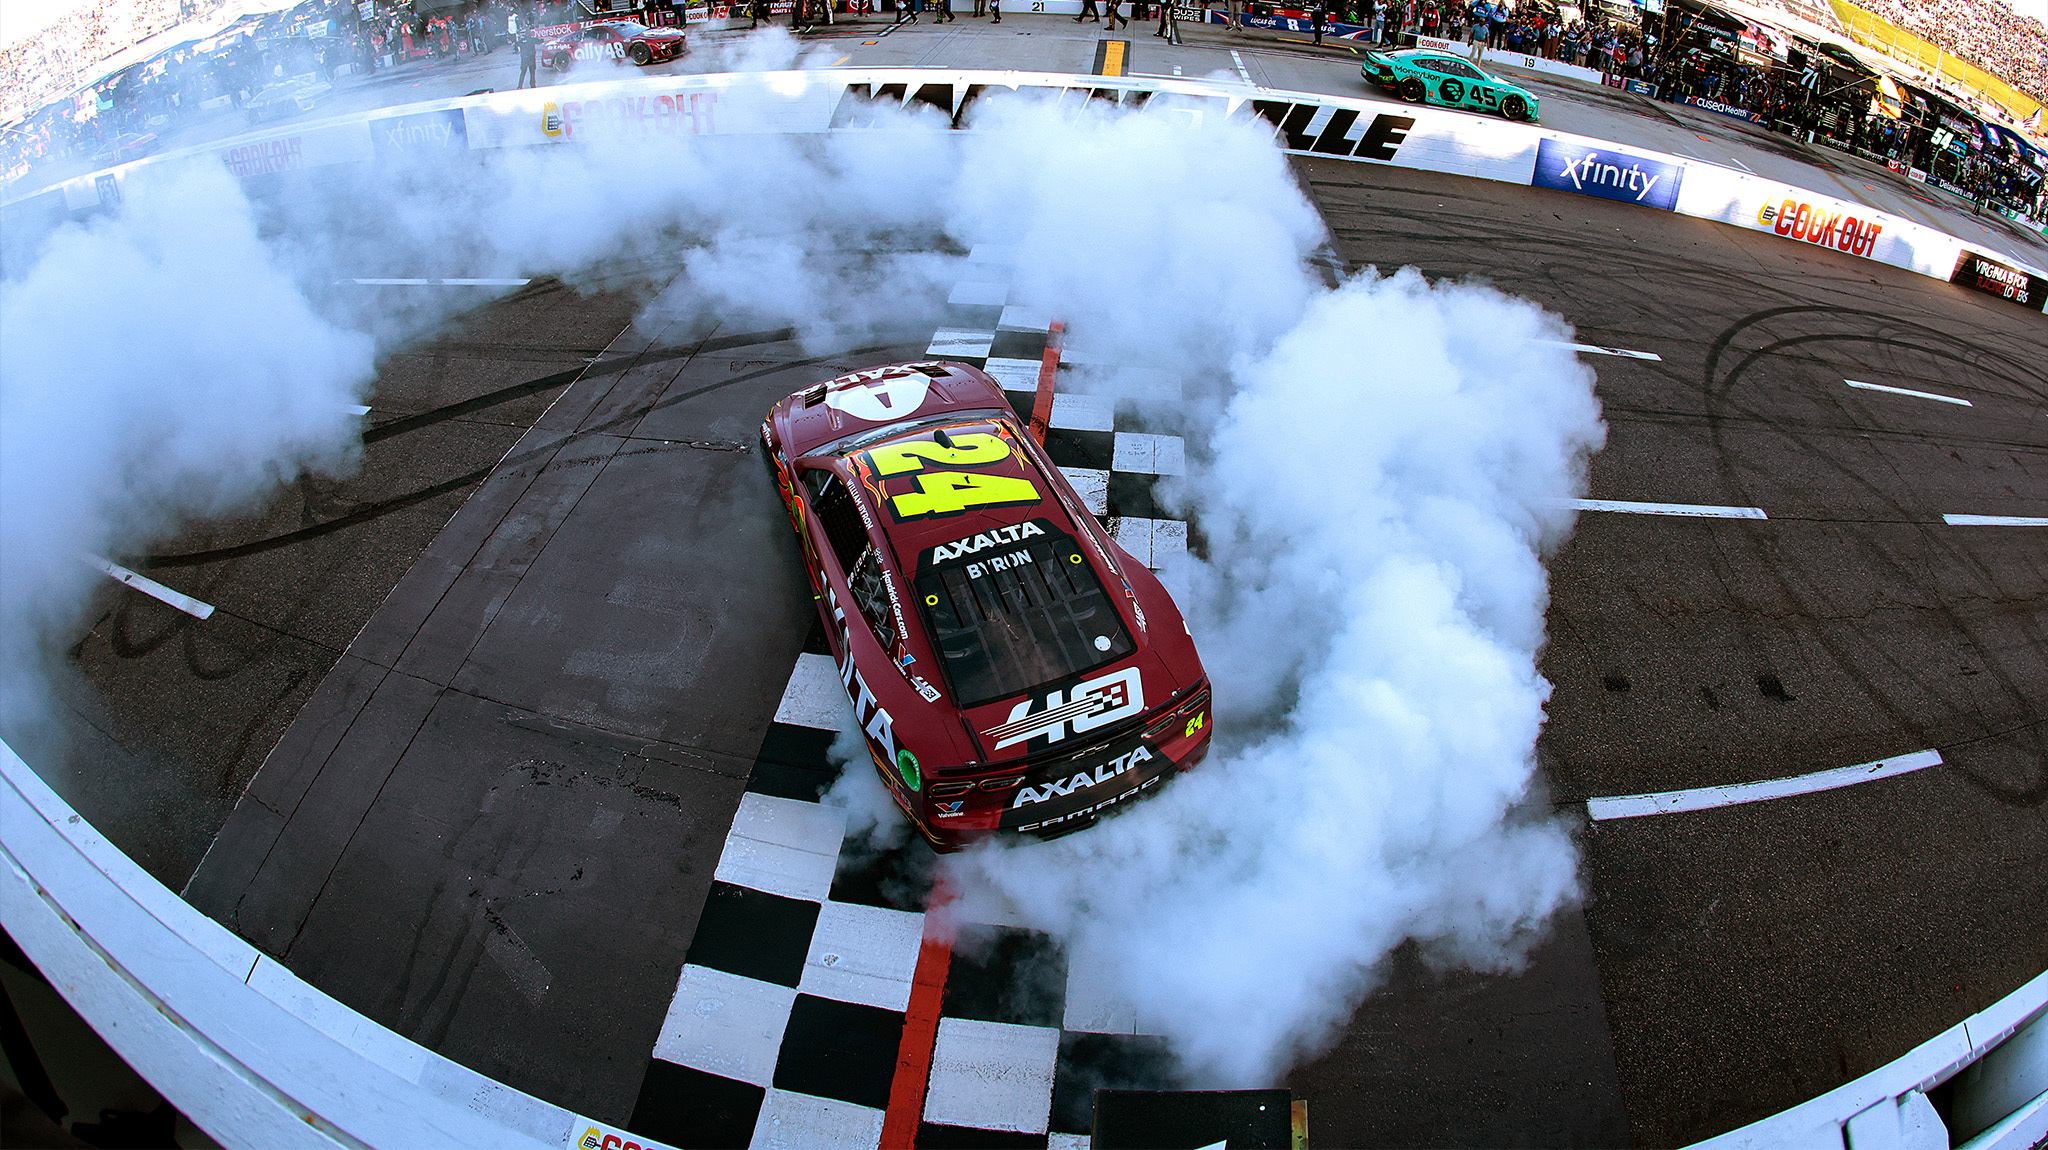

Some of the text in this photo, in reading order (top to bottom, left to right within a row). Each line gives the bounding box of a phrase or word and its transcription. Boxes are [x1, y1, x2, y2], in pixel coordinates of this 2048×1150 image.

[1031, 2, 1045, 11] 21
[1173, 9, 1200, 17] DUDE
[1250, 17, 1267, 25] LUCAS
[1287, 18, 1300, 31] 8
[574, 43, 604, 62] ally
[606, 42, 626, 60] 48
[1421, 39, 1450, 50] COOK OUT
[1394, 65, 1441, 82] MoneyLion
[1524, 57, 1535, 68] 19
[1800, 67, 1820, 90] 71
[1470, 85, 1497, 107] 45
[1724, 104, 1748, 118] Health
[1749, 112, 1763, 123] 71
[385, 118, 453, 153] xfinity
[1930, 127, 1954, 150] 54
[1560, 152, 1660, 201] xfinity
[2024, 168, 2043, 187] 77
[1939, 179, 1964, 197] Delaware
[1774, 199, 1882, 258] COOK OUT
[1976, 259, 2008, 283] VIRGINIA
[2012, 274, 2030, 290] FOR
[867, 433, 1042, 518] 24
[846, 479, 874, 530] WILLIAM BYRON
[933, 521, 1046, 565] AXALTA
[966, 549, 1033, 580] BYRON
[1185, 711, 1205, 738] 24
[1013, 745, 1154, 809] AXALTA
[1018, 775, 1160, 832] CAMARO
